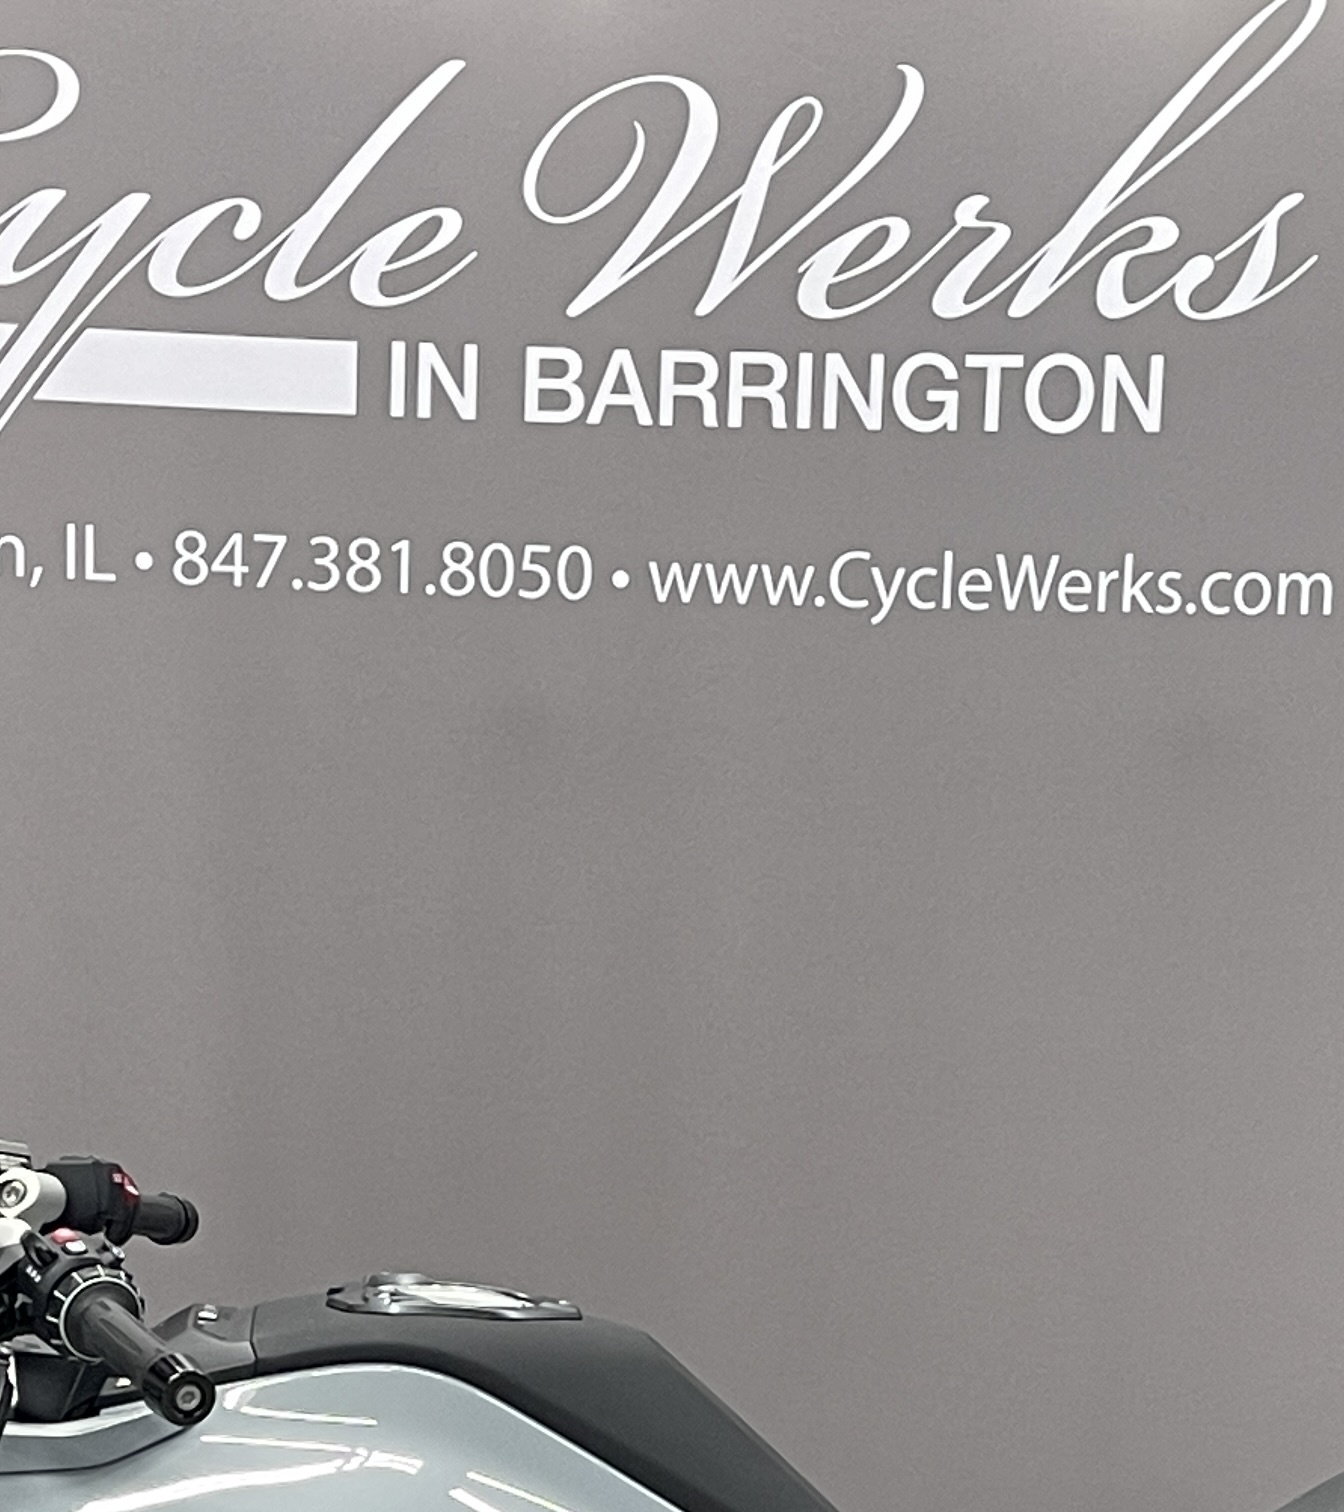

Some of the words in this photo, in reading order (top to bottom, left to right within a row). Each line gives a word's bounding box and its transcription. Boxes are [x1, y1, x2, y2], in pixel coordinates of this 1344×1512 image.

[522, 0, 1319, 321] Werks
[388, 339, 479, 421] IN
[522, 345, 1166, 435] BARRINGTON
[65, 522, 118, 583] IL
[171, 529, 594, 602] 847.381.8050
[647, 549, 1335, 626] www.CycleWerks.com
